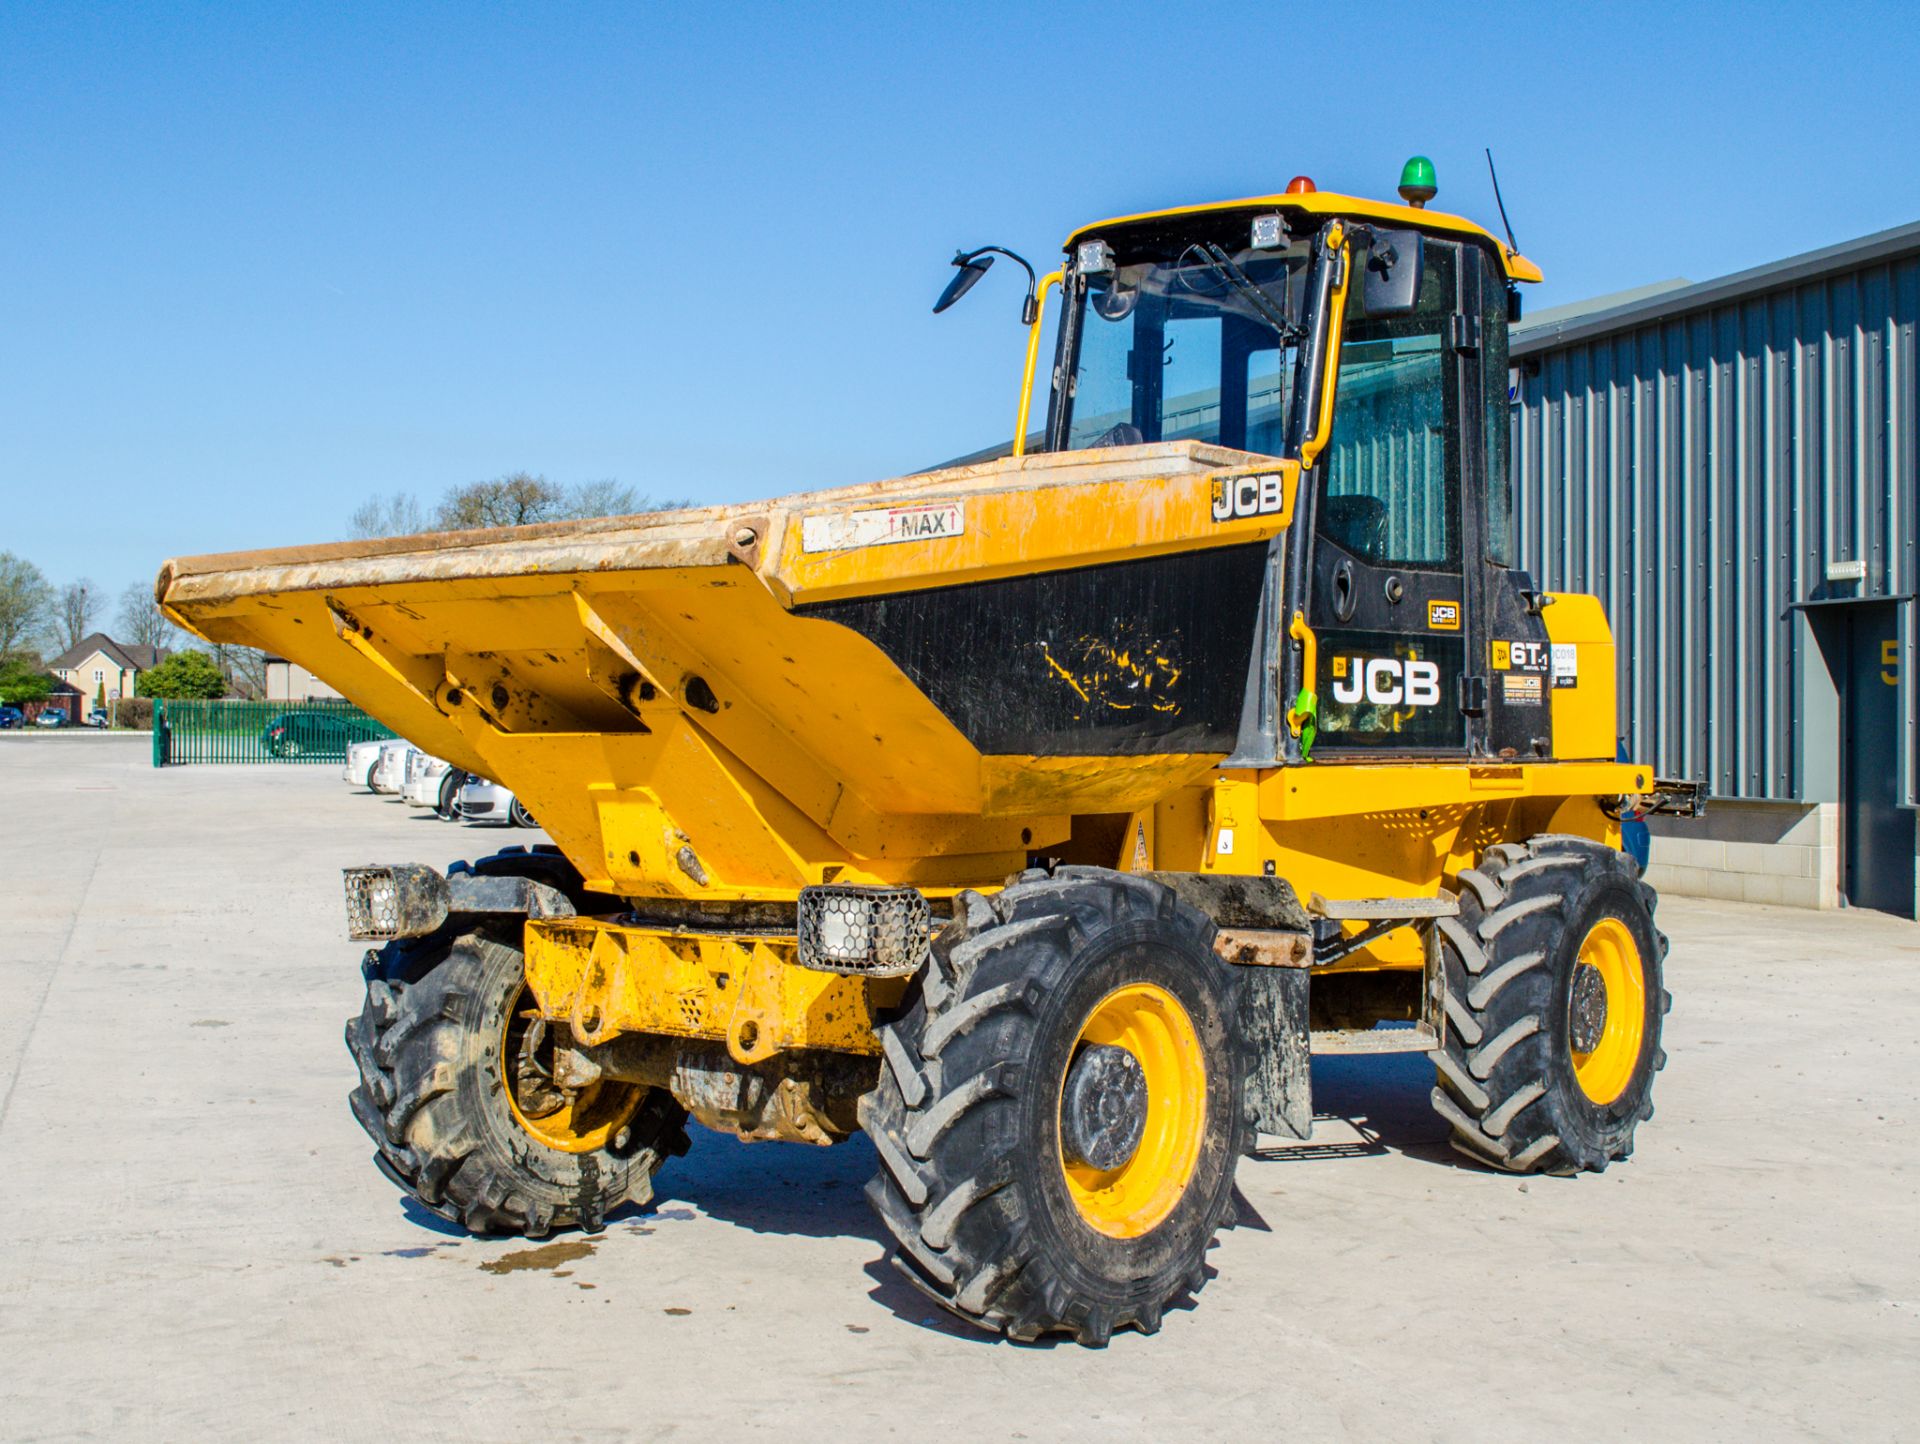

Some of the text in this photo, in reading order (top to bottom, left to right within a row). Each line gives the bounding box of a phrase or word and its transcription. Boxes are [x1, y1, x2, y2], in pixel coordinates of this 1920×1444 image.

[1213, 475, 1282, 518] JCB
[901, 512, 945, 538] MAX
[1432, 606, 1456, 619] JCB
[1333, 657, 1440, 706] JCB
[1881, 639, 1898, 686] 5
